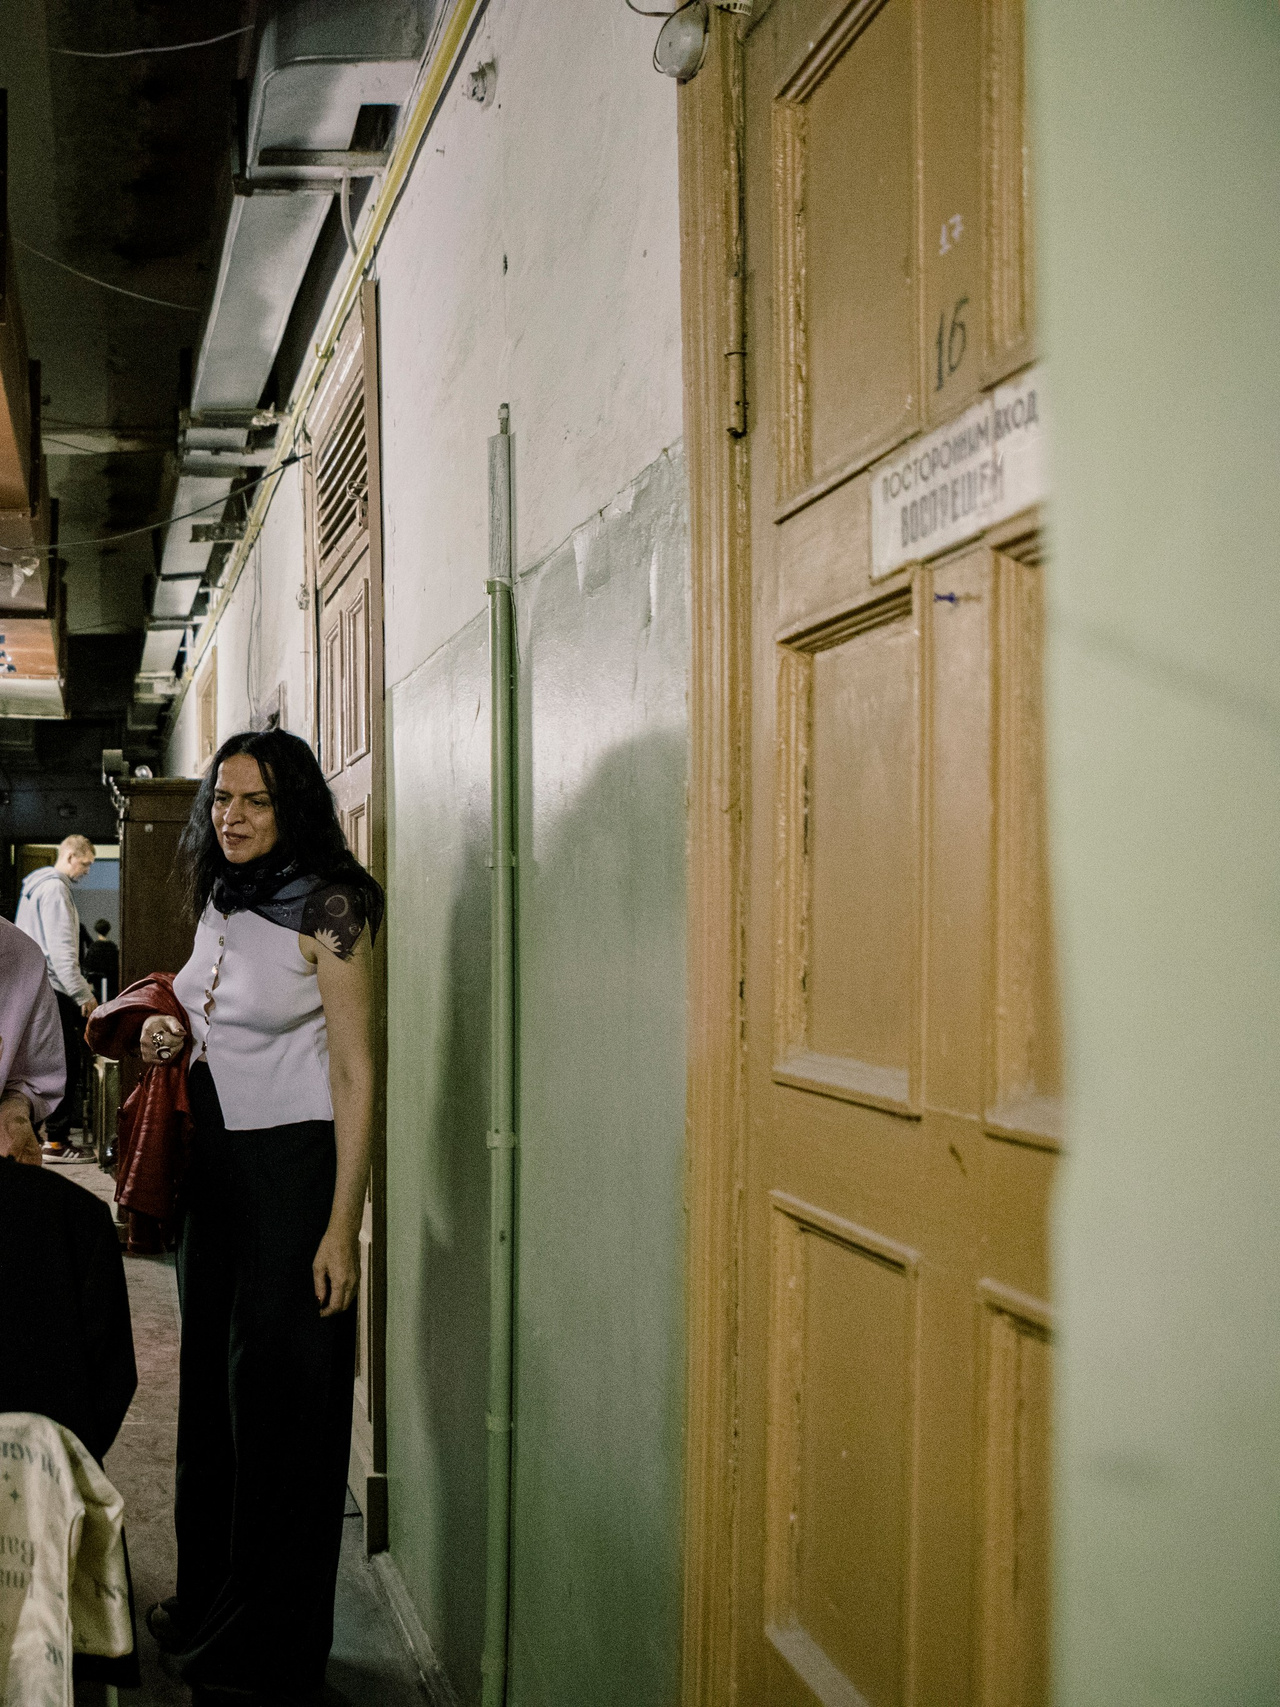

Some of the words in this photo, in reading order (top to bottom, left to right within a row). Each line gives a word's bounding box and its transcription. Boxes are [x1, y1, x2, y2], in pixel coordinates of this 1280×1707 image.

[938, 213, 964, 256] 17
[935, 297, 970, 392] 16
[882, 415, 990, 504] ПОСТОРОННИМ
[993, 389, 1039, 442] ВХОД
